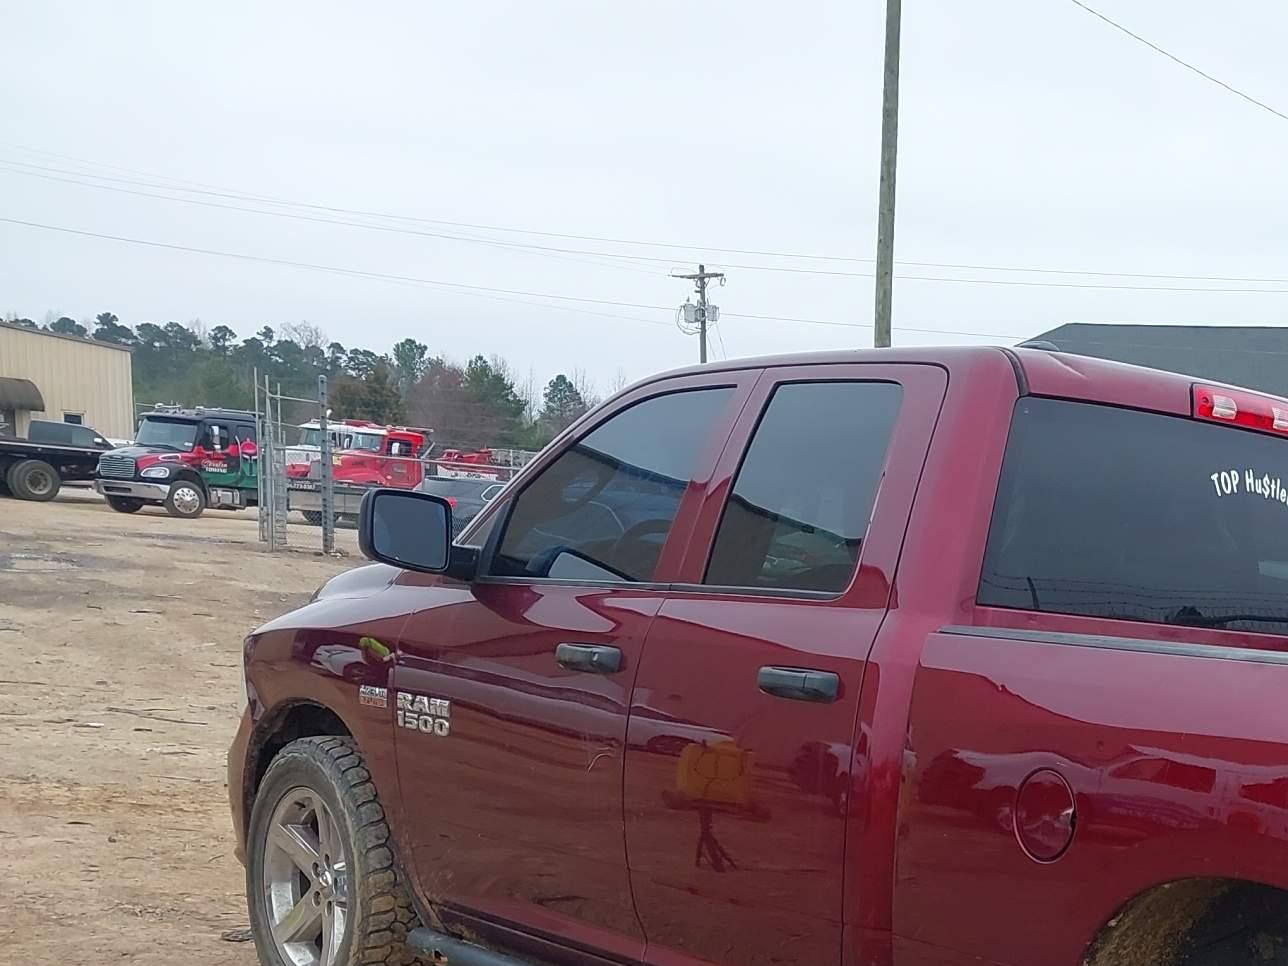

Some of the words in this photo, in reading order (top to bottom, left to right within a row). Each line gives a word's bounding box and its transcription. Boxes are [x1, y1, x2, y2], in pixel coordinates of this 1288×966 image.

[1210, 470, 1240, 497] TOP
[397, 691, 450, 718] RAM
[397, 710, 450, 737] 1500
